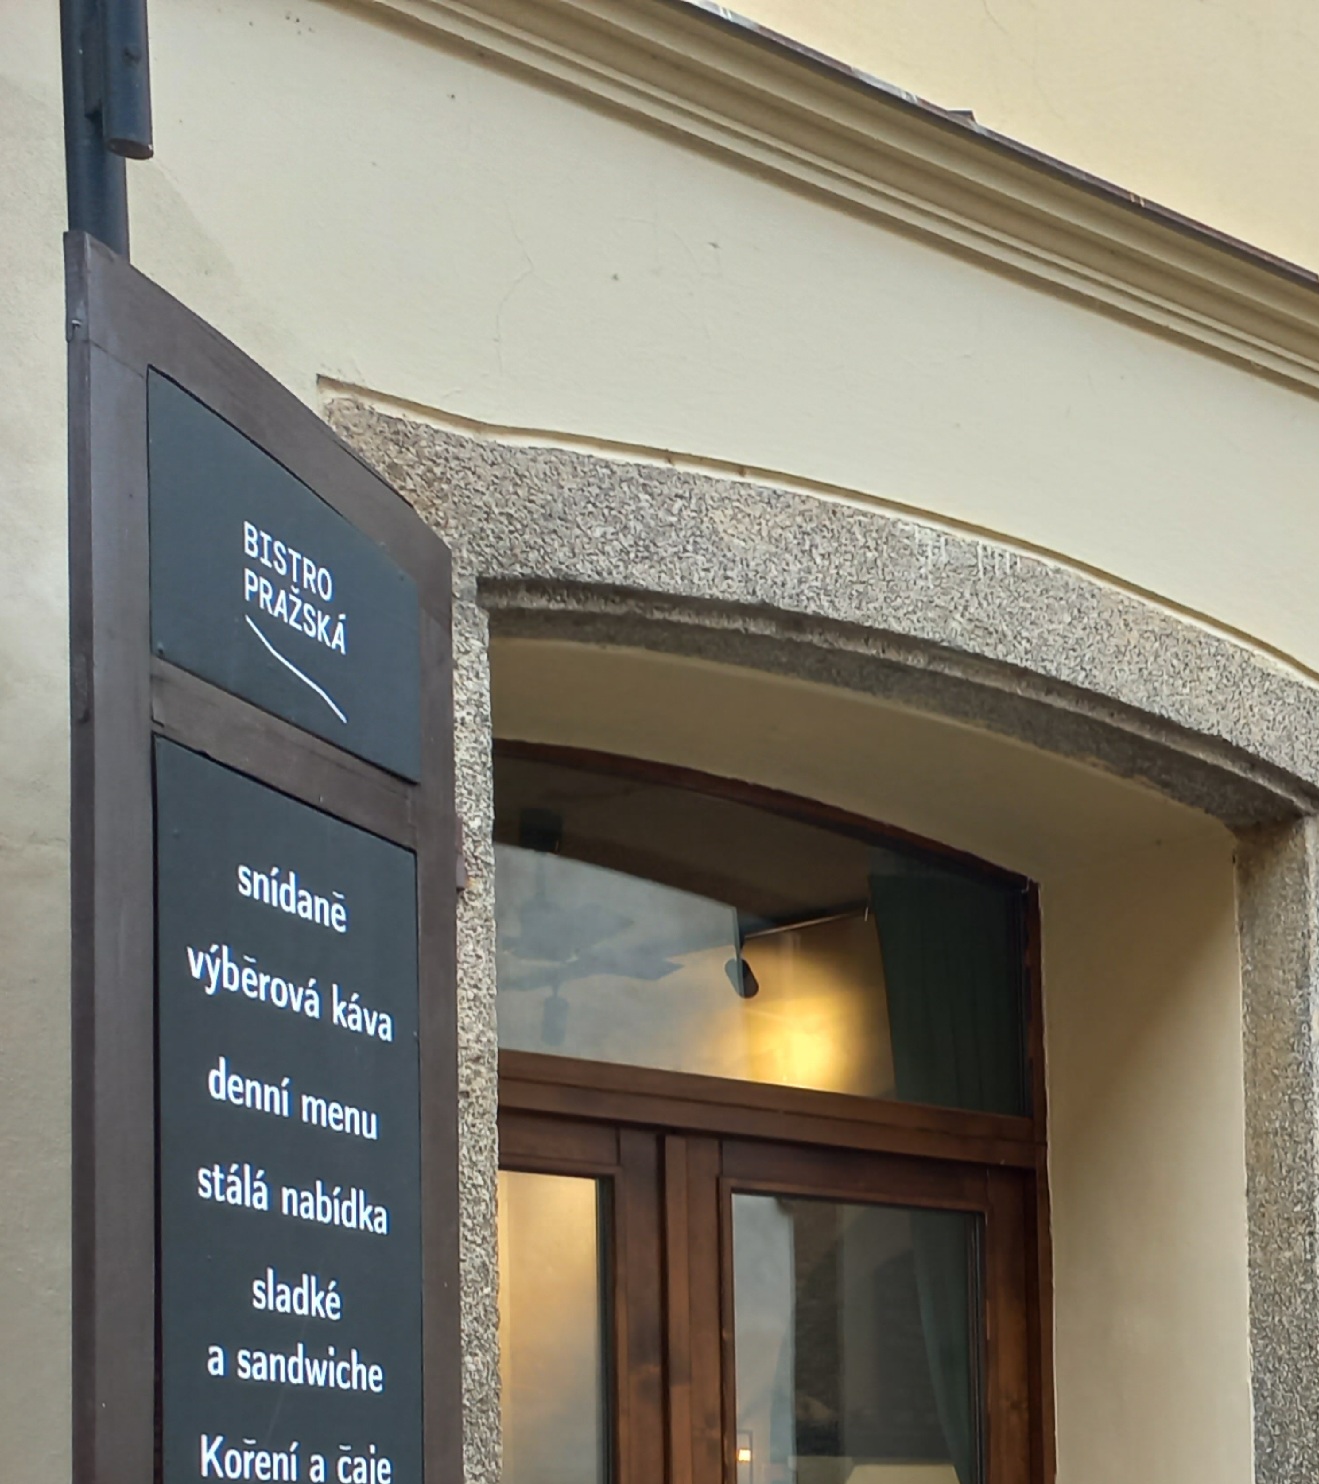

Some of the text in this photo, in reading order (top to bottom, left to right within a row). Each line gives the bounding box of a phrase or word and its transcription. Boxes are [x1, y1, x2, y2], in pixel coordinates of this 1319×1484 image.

[243, 520, 333, 601] BISTRO
[244, 566, 347, 656] PRAŽSKÁ
[332, 983, 393, 1042] káva
[207, 1056, 378, 1140] denní menu
[197, 1163, 389, 1235] stálá nabídka
[251, 1266, 342, 1320] sladké
[207, 1343, 384, 1393] a sandwiche
[309, 1452, 325, 1484] a
